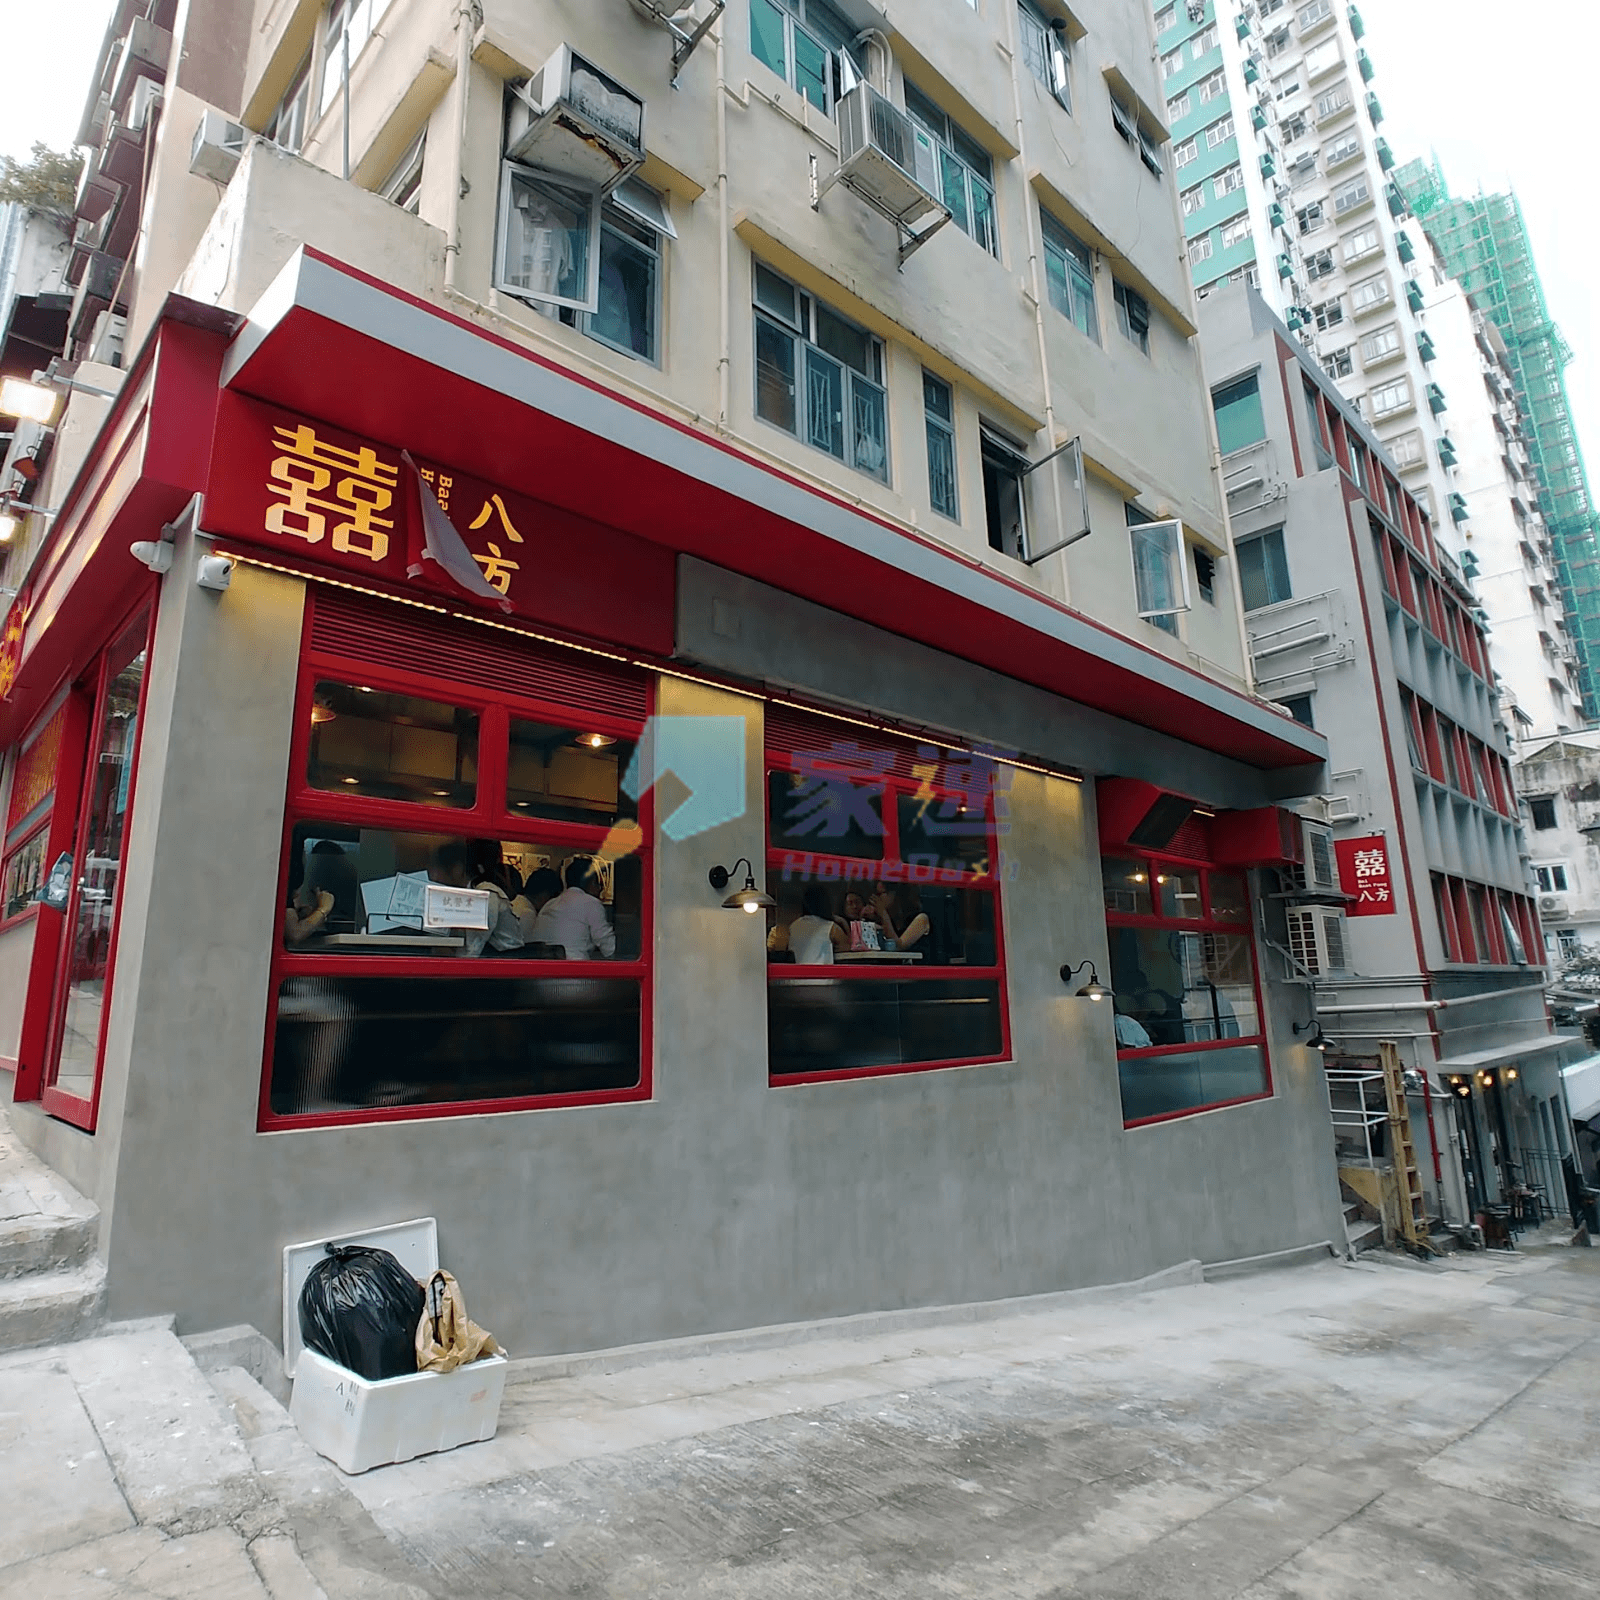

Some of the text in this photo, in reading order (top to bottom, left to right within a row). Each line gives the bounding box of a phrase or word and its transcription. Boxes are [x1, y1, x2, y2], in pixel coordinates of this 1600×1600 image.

[264, 424, 399, 562] 囍
[468, 493, 524, 596] 八方
[1354, 849, 1386, 877] 囍
[1359, 888, 1390, 902] 八方
